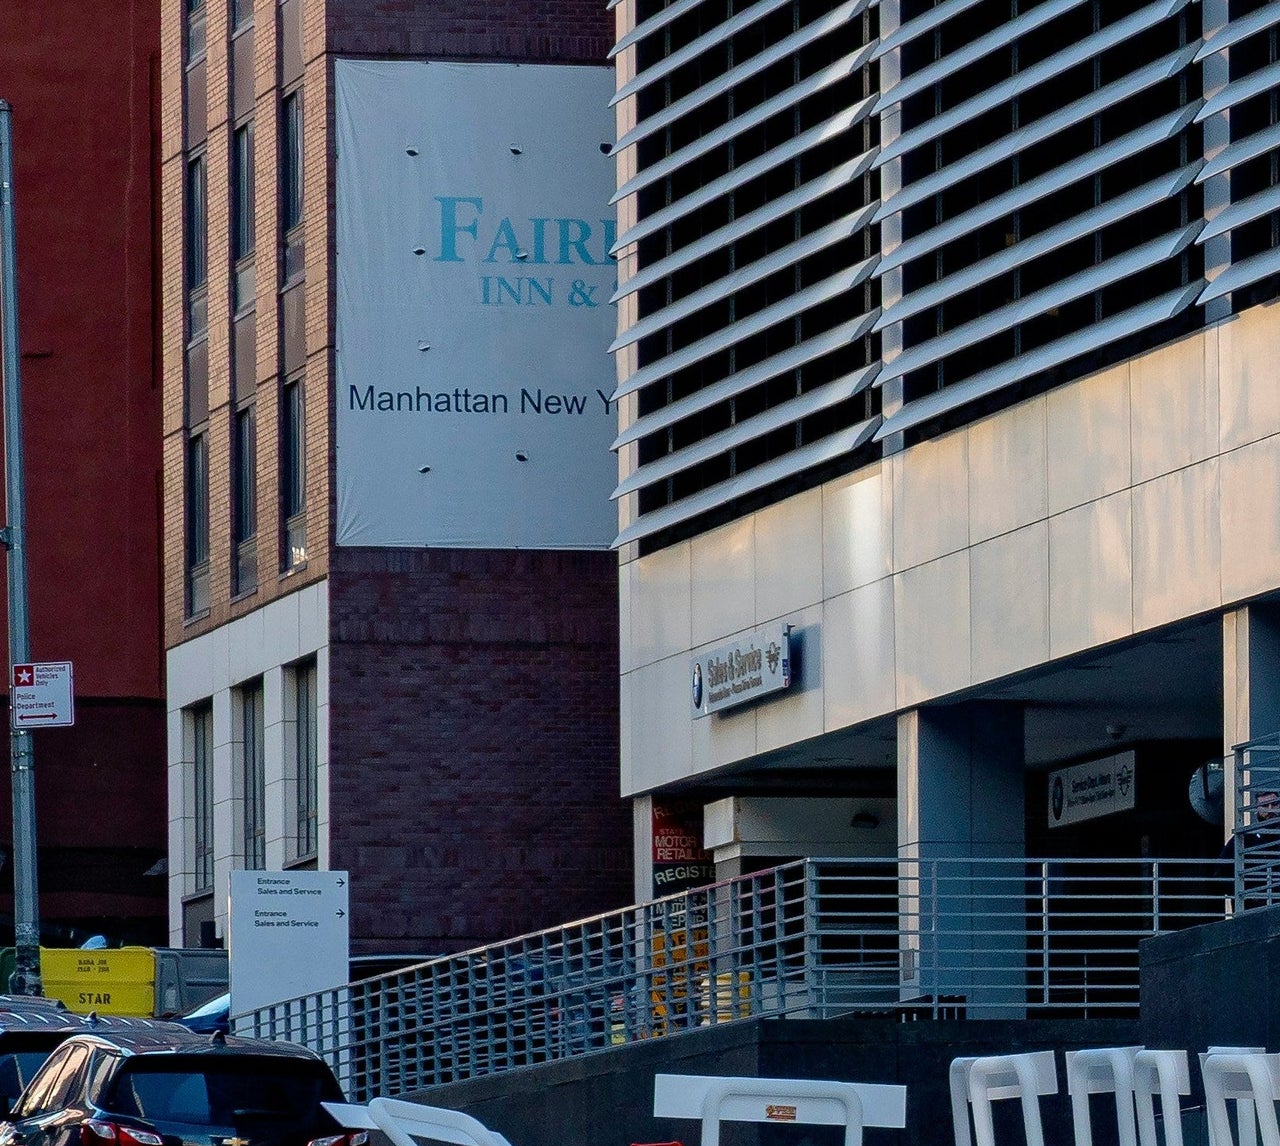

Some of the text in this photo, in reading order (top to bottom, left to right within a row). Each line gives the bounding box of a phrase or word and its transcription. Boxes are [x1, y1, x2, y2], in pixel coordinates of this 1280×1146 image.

[479, 275, 554, 306] INN
[567, 278, 600, 308] &
[349, 384, 618, 415] Manhattan New Y
[734, 643, 762, 679] Service
[17, 701, 55, 710] Department
[654, 835, 697, 849] MOTOR
[656, 848, 696, 861] RETAIL
[293, 888, 322, 896] Service
[290, 919, 319, 927] Service
[79, 992, 111, 1005] STAR
